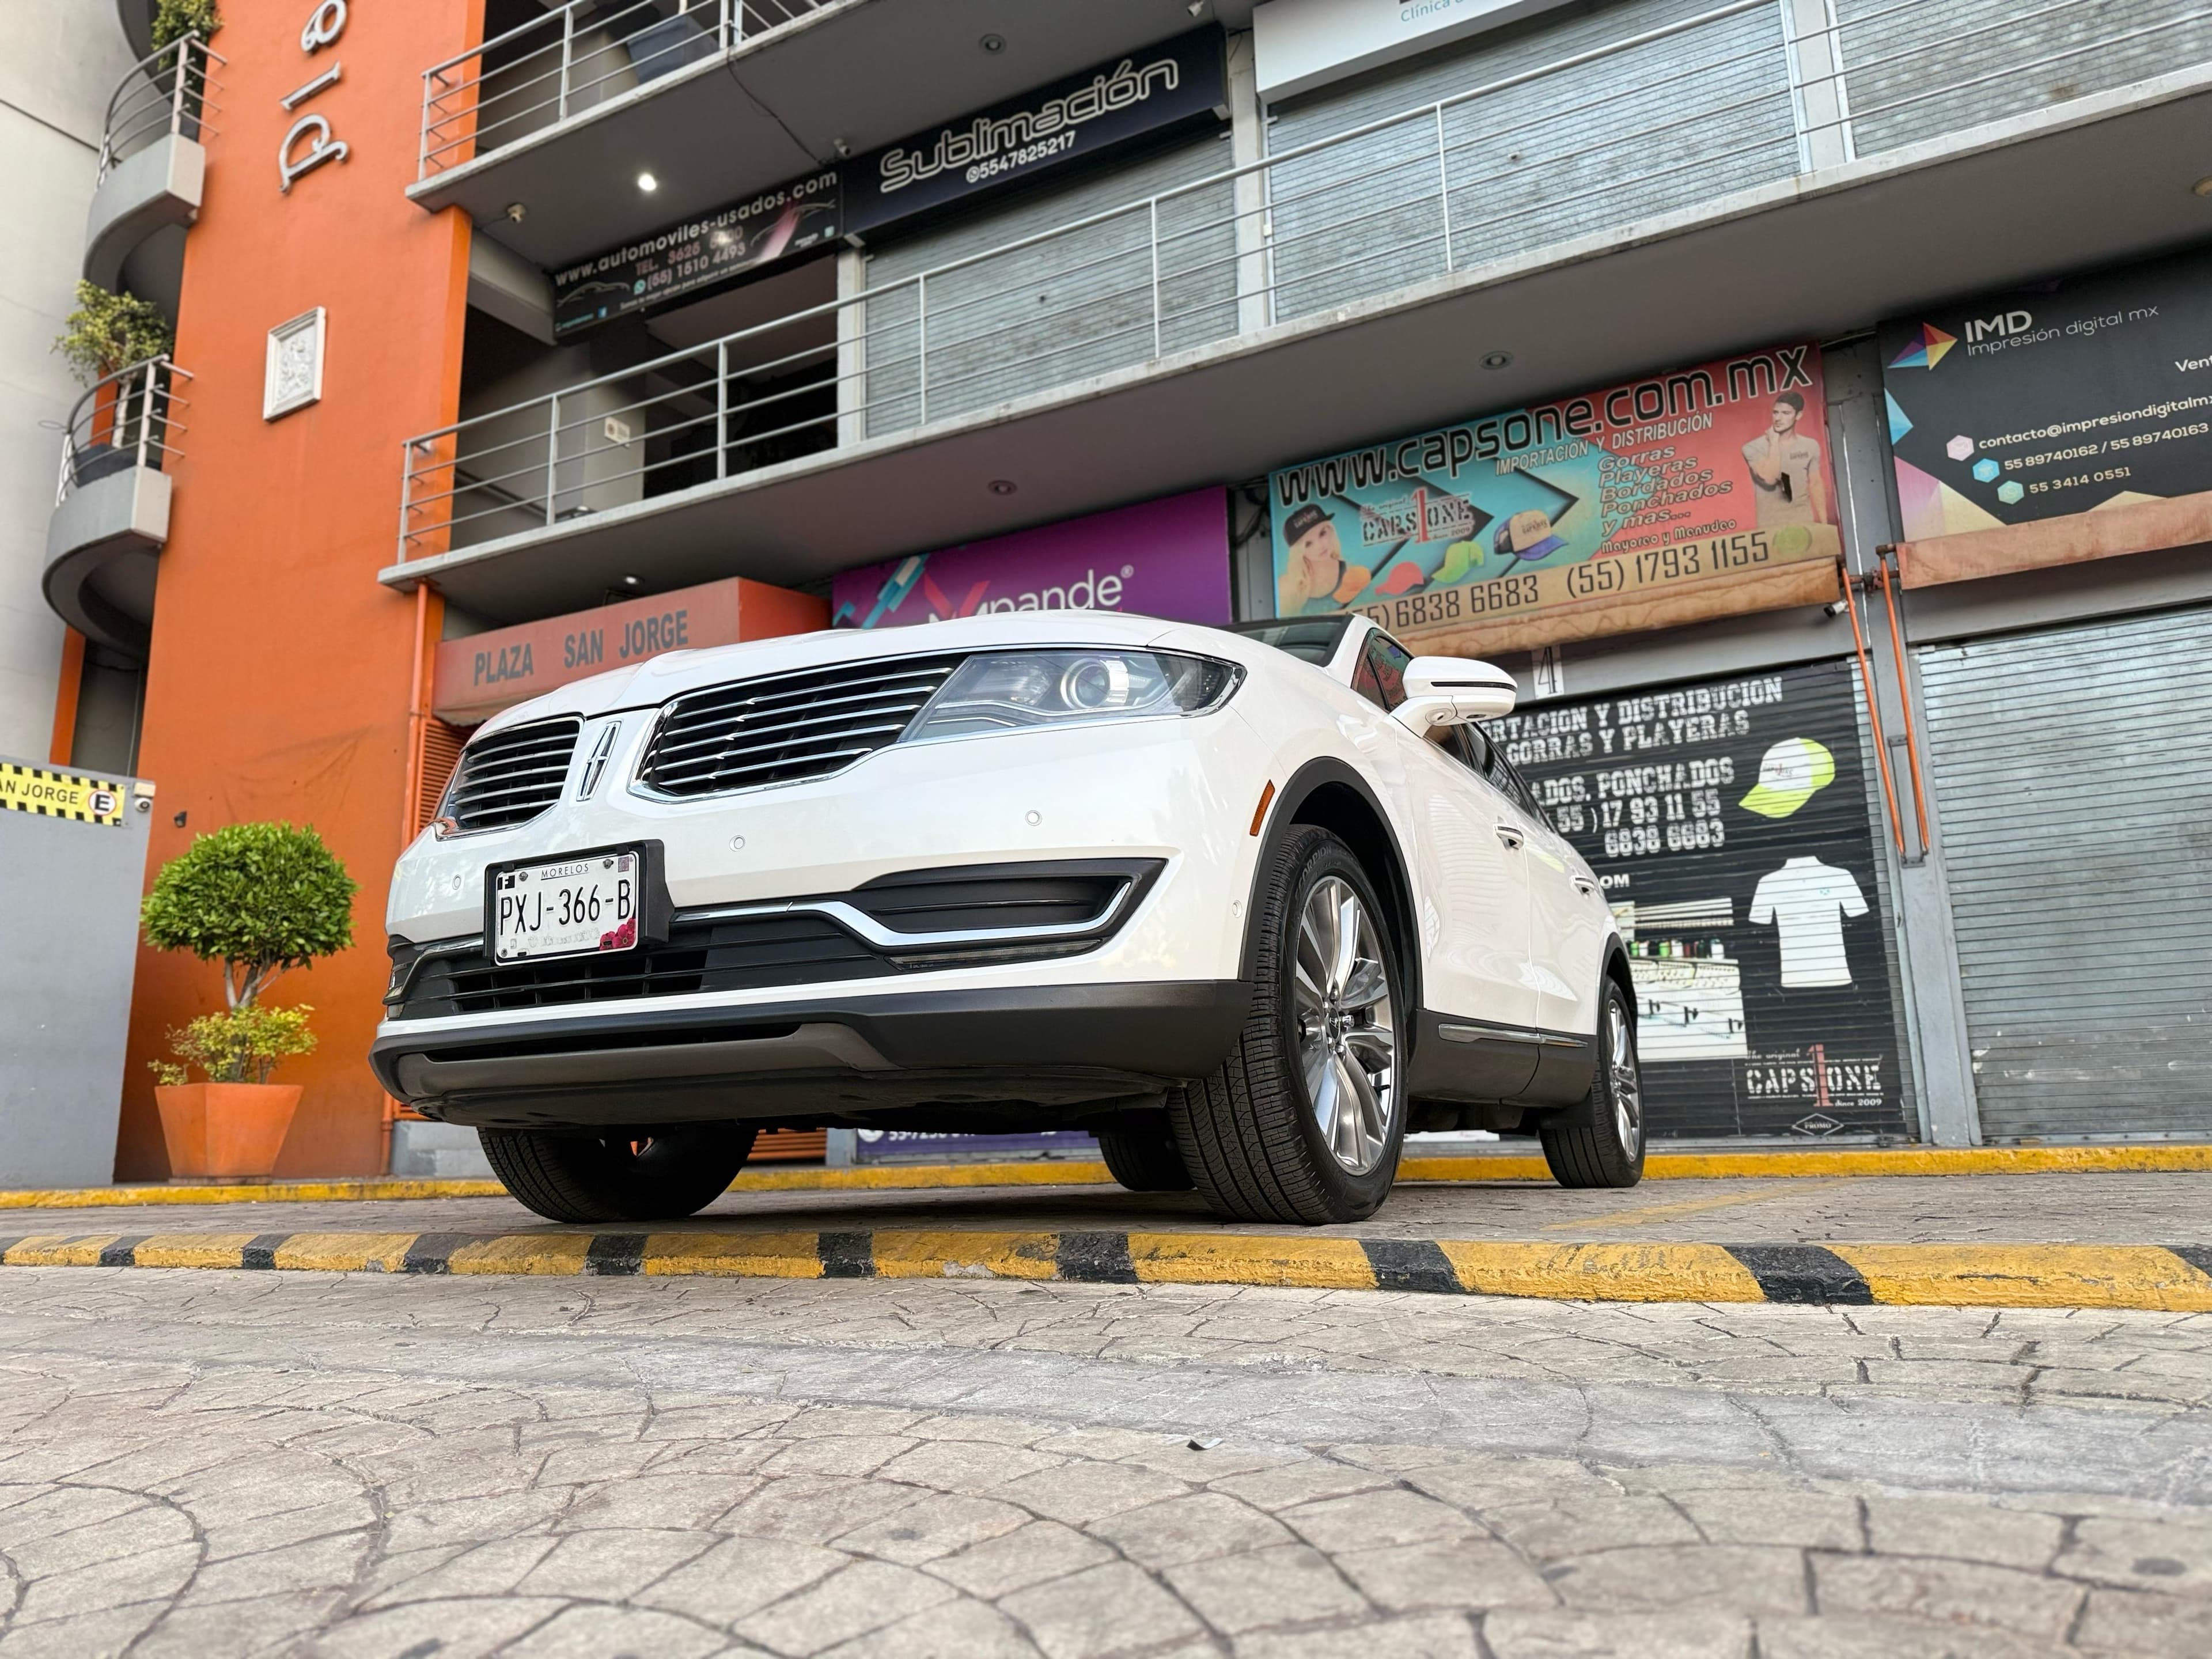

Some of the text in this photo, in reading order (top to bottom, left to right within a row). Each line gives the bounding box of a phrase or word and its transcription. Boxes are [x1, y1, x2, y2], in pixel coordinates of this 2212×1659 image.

[1400, 0, 1450, 22] Clínica
[880, 59, 1179, 194] Sublimación
[978, 131, 1076, 179] 5547825217
[555, 172, 838, 286] www.automoviles-usados.com
[1964, 310, 2032, 343] IMD
[1967, 306, 2159, 356] Impresión digital mx
[1277, 345, 1812, 507] www.capsone.com.mx
[1496, 411, 1713, 476] IMPORTACIÓN Y DISTRIBUCIÓN
[1598, 445, 1676, 472] Gorras
[2004, 459, 2023, 471] 55
[2025, 444, 2099, 467] 89740162
[2111, 438, 2130, 450] 55
[2132, 423, 2209, 446] 89740163
[1599, 456, 1698, 488] Playeras
[1600, 469, 1714, 503] Bordados
[2029, 467, 2131, 494] 55 3414 0551
[1601, 480, 1733, 518] Ponchados
[1601, 519, 1737, 554] Mayoreo y Menudeo
[1602, 519, 1617, 537] y
[1396, 590, 1460, 628] 6838
[1471, 575, 1539, 613] 6683
[1567, 559, 1624, 598] (55)
[1636, 544, 1700, 584] 1793
[1711, 531, 1769, 570] 1155
[474, 610, 688, 687] PLAZA SAN JORGE
[1538, 646, 1558, 694] 4
[1594, 703, 1611, 727] Y
[1617, 676, 1783, 725] DISTRIBUCION
[1506, 710, 1750, 766] GORRAS Y PLAYERAS
[22, 783, 79, 804] JORGE
[1596, 756, 1735, 799] PONCHADOS
[94, 794, 111, 812] E
[1629, 796, 1659, 824] 93
[1664, 793, 1686, 821] 11
[1691, 788, 1721, 818] 55
[1604, 818, 1725, 858] 6838 6683
[541, 863, 589, 878] MORELOS
[500, 879, 631, 936] PXJ-366-B
[1766, 1048, 1801, 1060] original
[1858, 1098, 1882, 1107] 2009
[1804, 1122, 1832, 1130] PROMO
